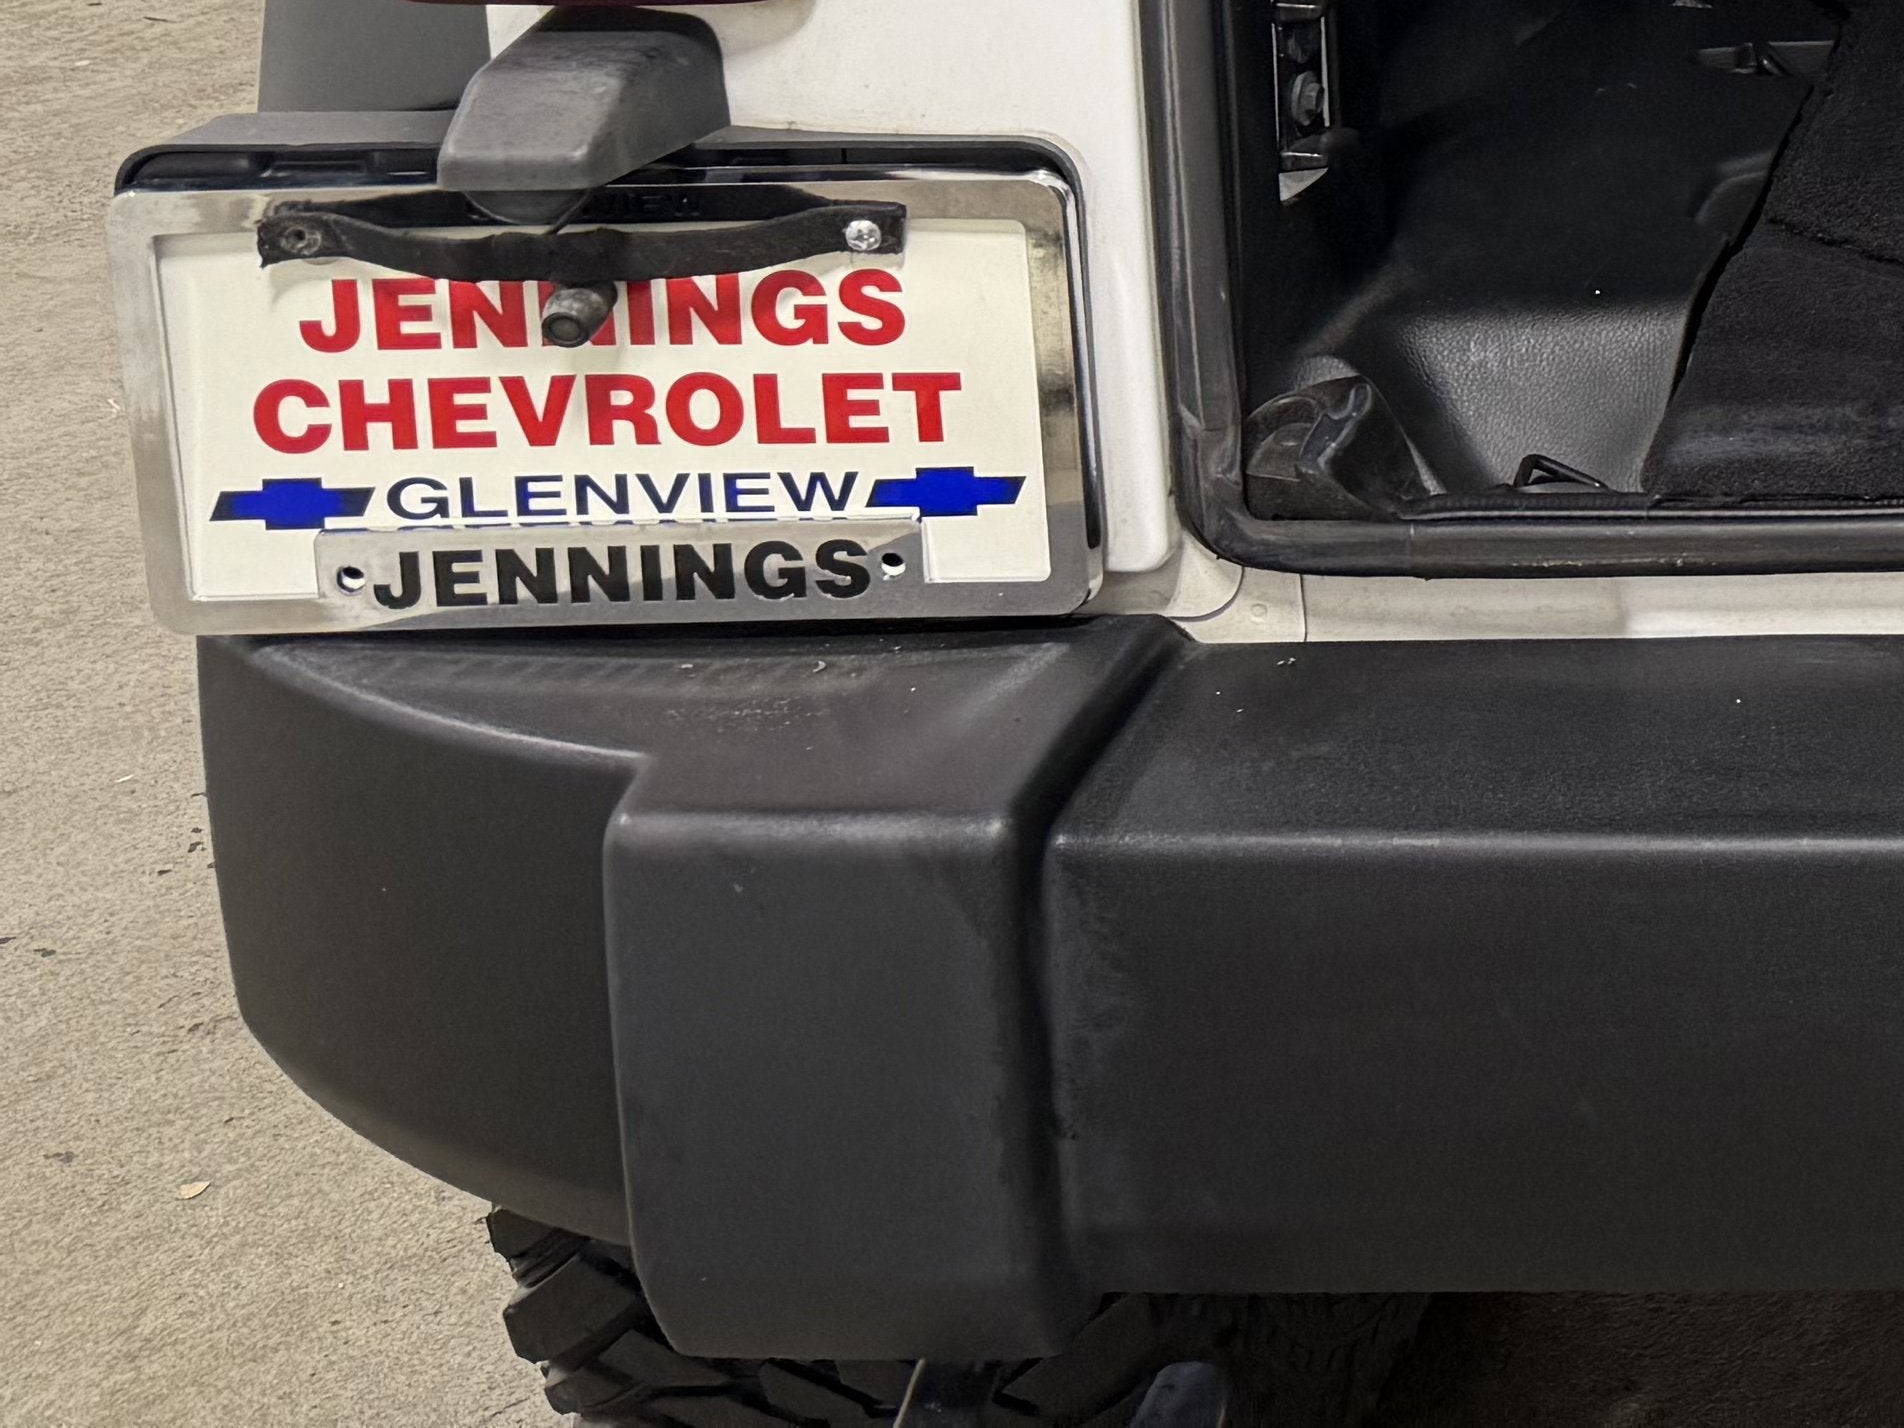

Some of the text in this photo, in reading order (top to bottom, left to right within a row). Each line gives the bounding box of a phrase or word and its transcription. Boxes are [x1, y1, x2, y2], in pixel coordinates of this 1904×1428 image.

[300, 269, 905, 353] JENINGS
[253, 372, 961, 454] CHEVROLET
[385, 471, 860, 519] GLENVIEW
[372, 540, 872, 610] JENNINGS
